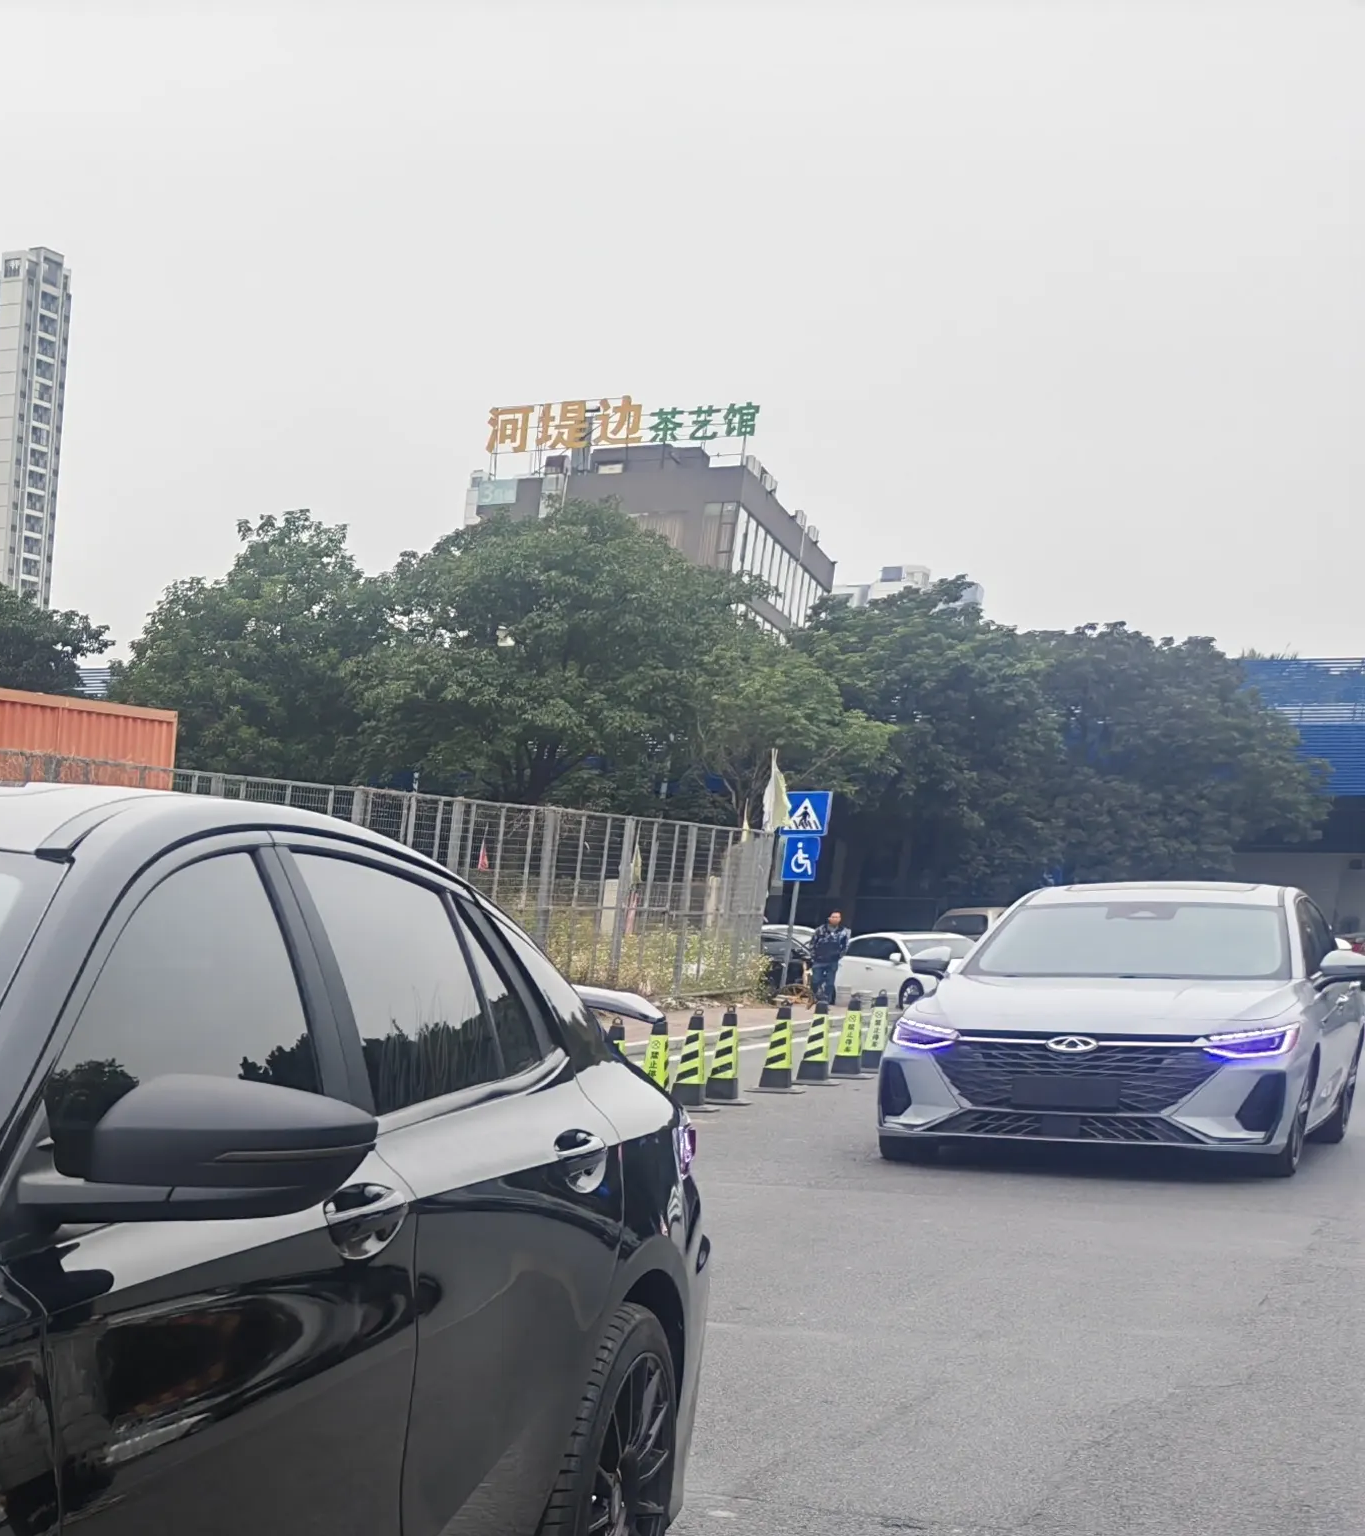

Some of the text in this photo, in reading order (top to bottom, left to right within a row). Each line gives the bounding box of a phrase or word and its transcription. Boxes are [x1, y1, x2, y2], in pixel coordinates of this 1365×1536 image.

[485, 395, 760, 454] 河堤边 茶艺馆
[648, 1051, 659, 1078] 禁止停
